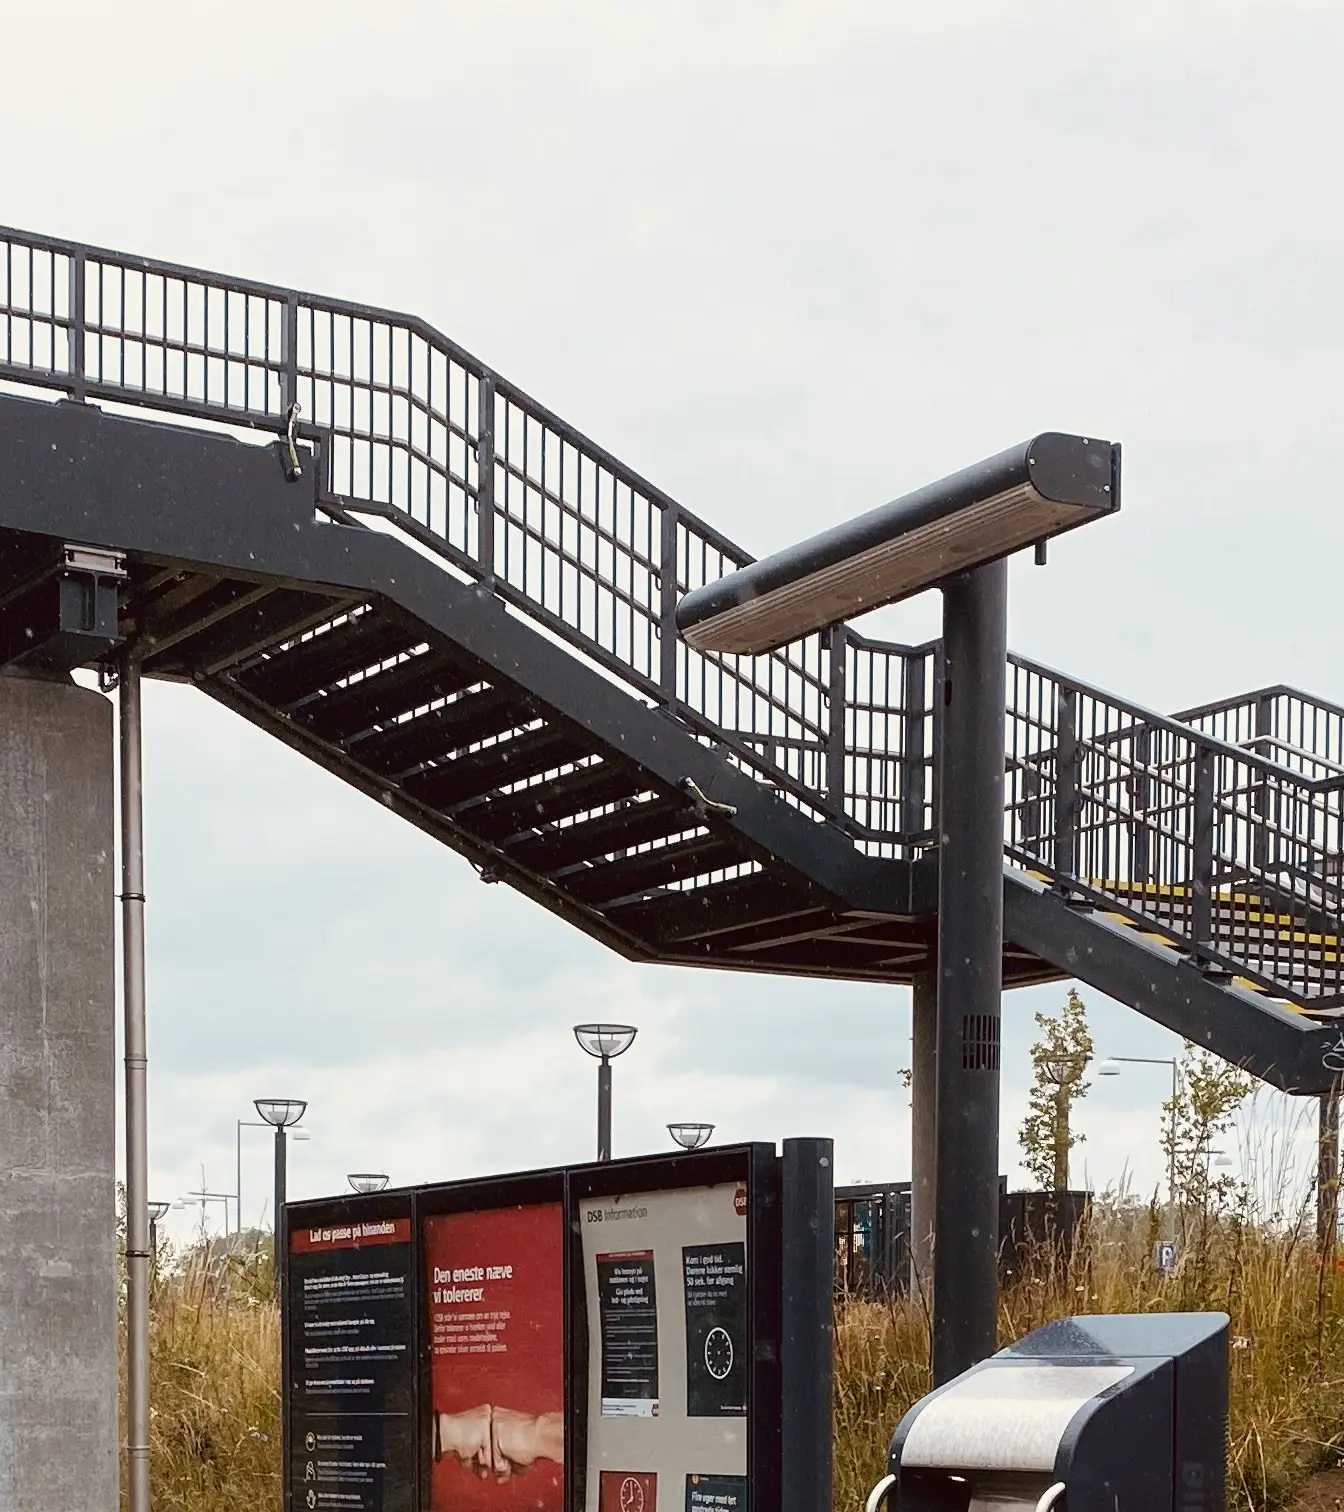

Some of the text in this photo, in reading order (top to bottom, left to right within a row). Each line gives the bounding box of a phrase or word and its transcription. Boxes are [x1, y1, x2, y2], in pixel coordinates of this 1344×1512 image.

[587, 1206, 648, 1223] DSB Information
[309, 1228, 322, 1243] Lad
[323, 1230, 332, 1242] os
[332, 1227, 352, 1243] passe
[352, 1224, 362, 1241] på
[434, 1265, 513, 1283] Den eneste næve
[433, 1285, 485, 1303] vi tolererer.
